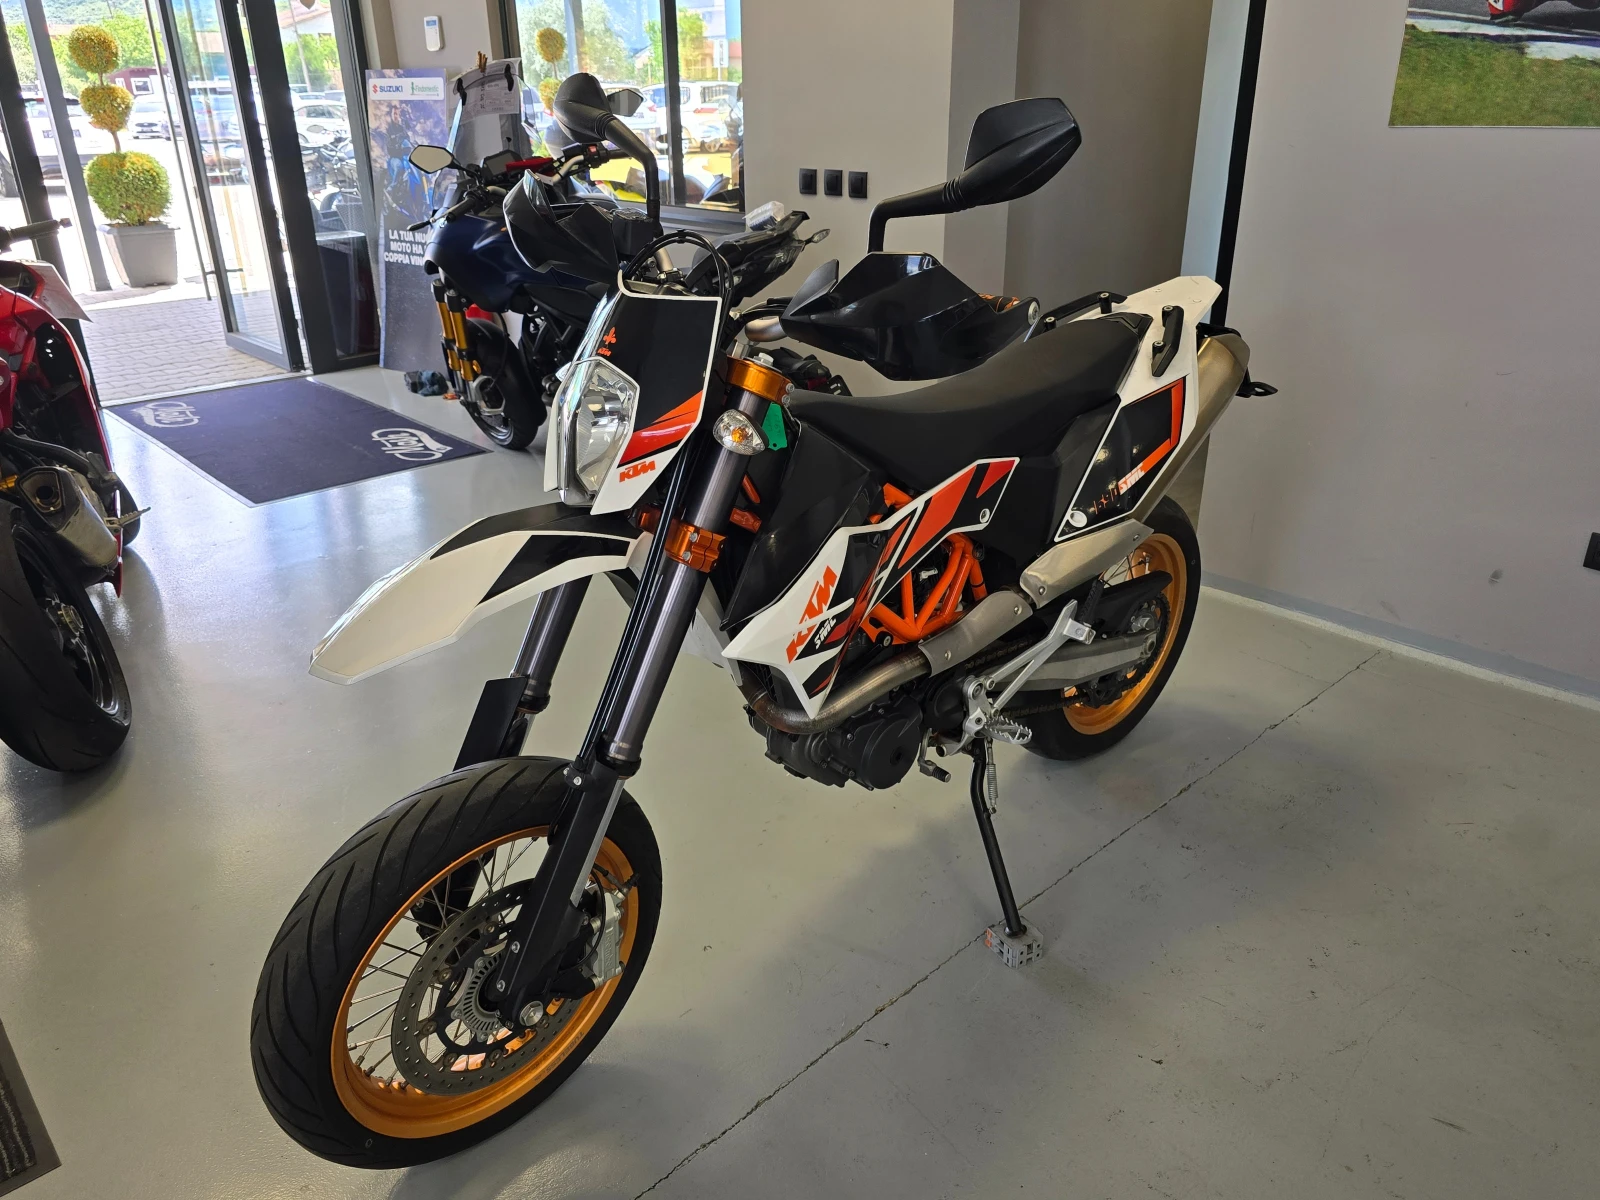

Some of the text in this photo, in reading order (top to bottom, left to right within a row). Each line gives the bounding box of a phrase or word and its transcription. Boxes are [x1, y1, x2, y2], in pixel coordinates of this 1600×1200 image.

[379, 85, 403, 93] SUZUKI
[388, 229, 399, 240] LA
[399, 230, 414, 242] TUA
[390, 241, 424, 255] MOTO HA
[383, 252, 410, 265] COPPIA
[619, 460, 656, 482] KTM
[786, 565, 837, 664] KTM
